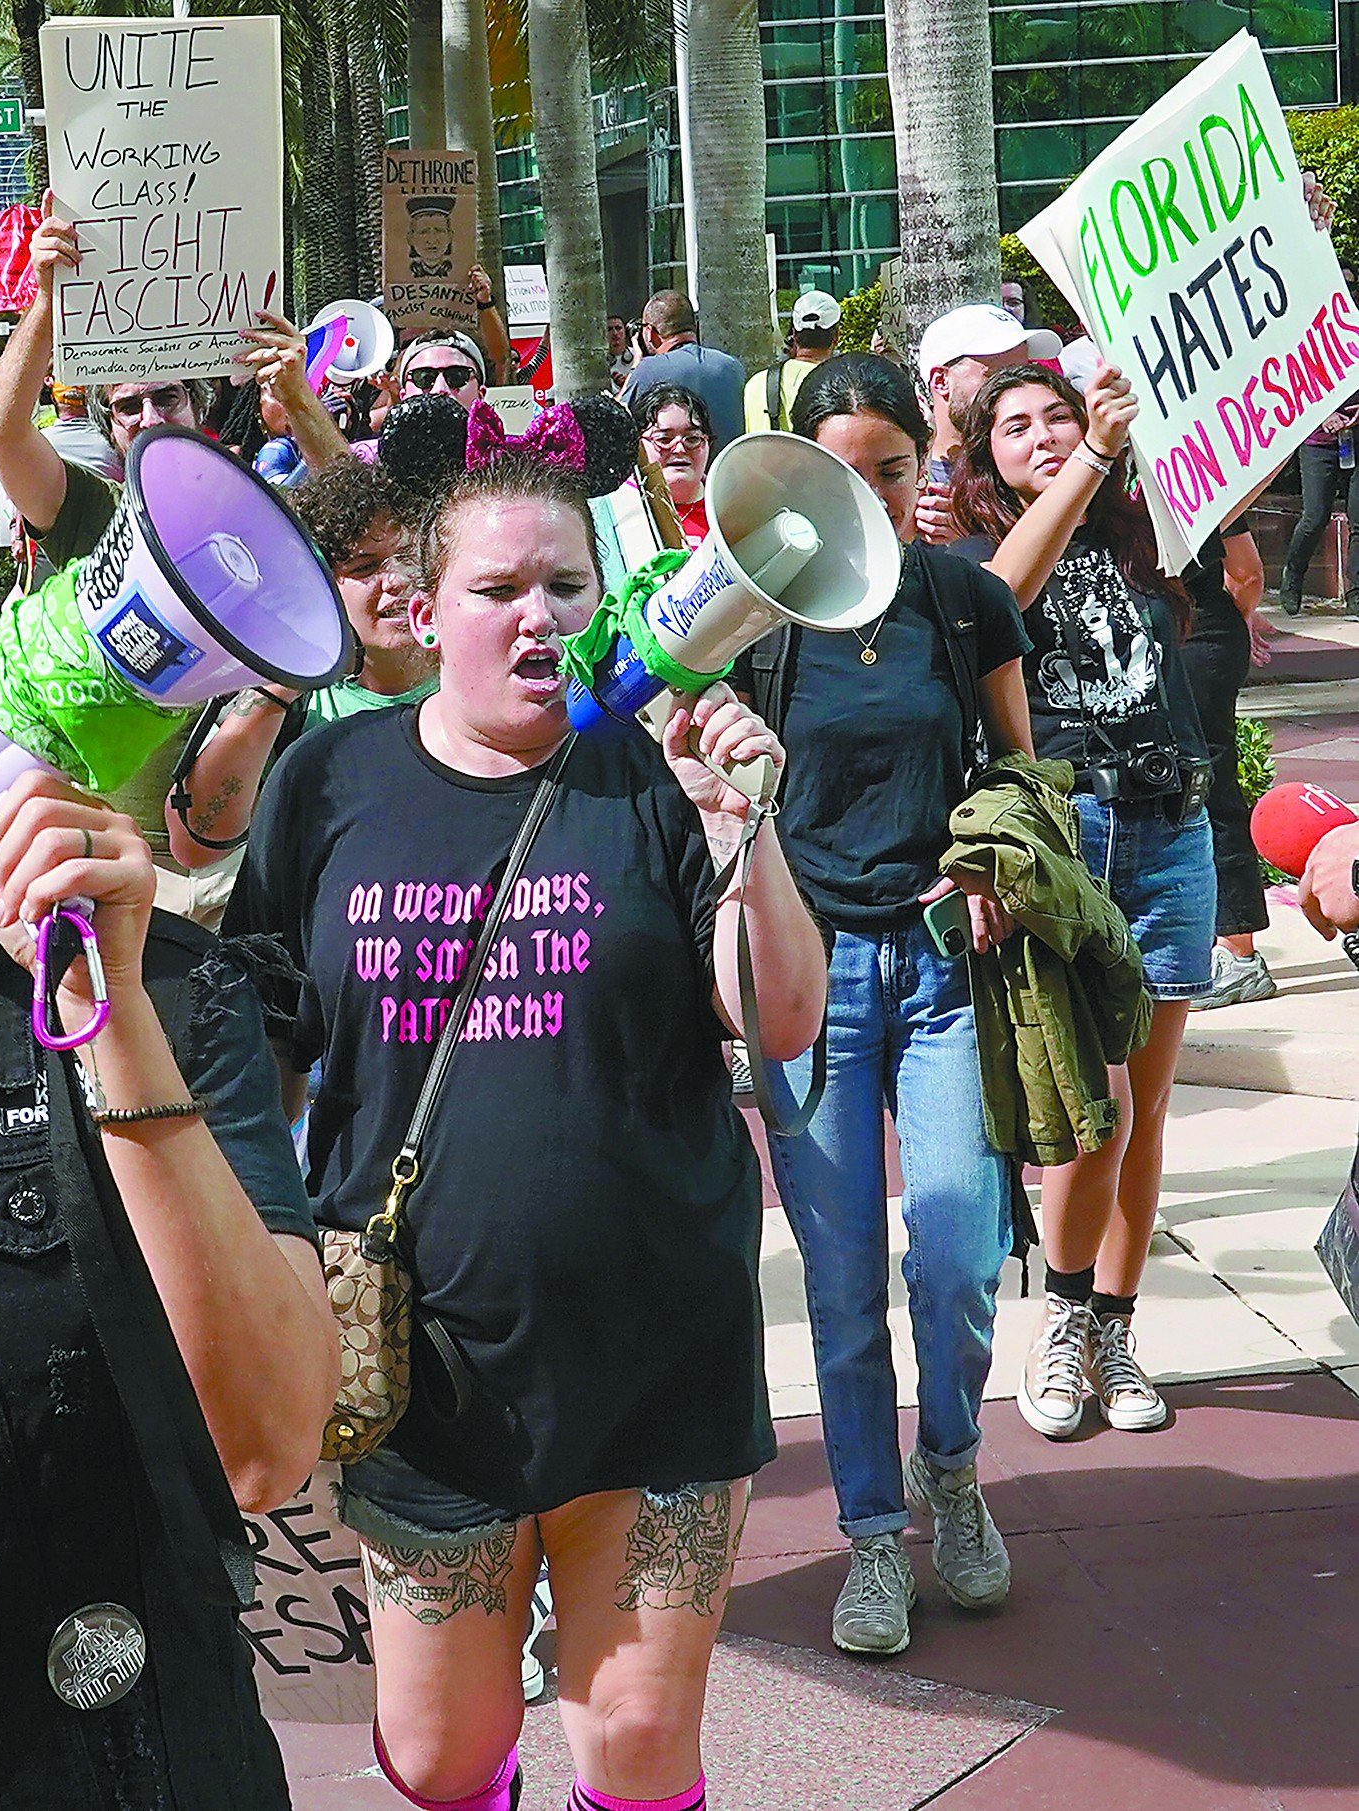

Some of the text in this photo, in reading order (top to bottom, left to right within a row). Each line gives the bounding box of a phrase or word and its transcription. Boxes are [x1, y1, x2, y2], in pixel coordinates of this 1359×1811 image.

[66, 26, 225, 92] UNITE
[116, 100, 169, 119] THE
[63, 127, 221, 171] WORKING
[91, 172, 197, 210] CLASS!
[385, 157, 475, 186] DETHRONE
[401, 186, 457, 195] LITTLE
[1079, 82, 1285, 343] FLORIDA
[72, 207, 243, 277] FIGHT
[59, 270, 277, 336] FASCISM!
[390, 284, 475, 306] DESANTIS
[1132, 225, 1288, 420] HATES
[63, 346, 130, 362] Democratic
[1155, 290, 1359, 528] RON DESANTIS
[87, 518, 134, 611] rights
[106, 633, 117, 648] I
[346, 881, 384, 925] ON
[355, 927, 592, 984] WE SMSH THE
[379, 990, 565, 1044] PATRARCHY
[6, 1104, 50, 1128] FOR
